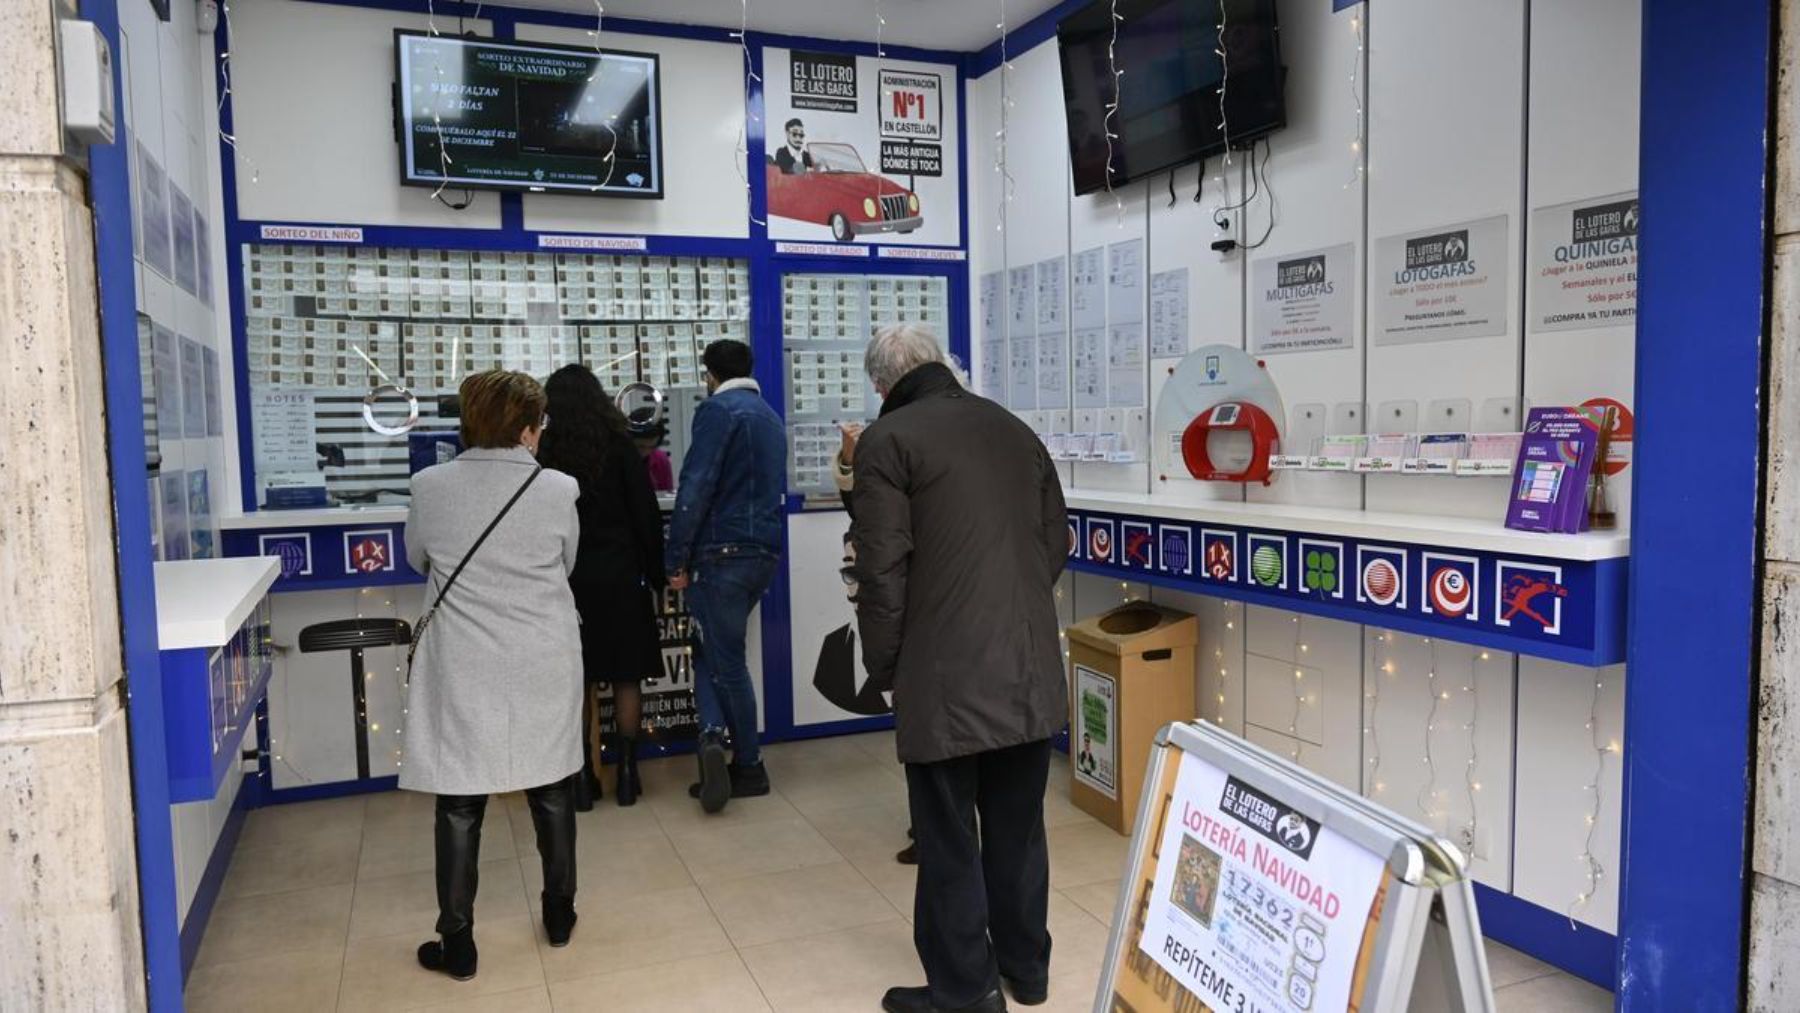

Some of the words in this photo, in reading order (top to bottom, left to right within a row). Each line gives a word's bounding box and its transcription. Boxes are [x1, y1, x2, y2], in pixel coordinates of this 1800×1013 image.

[477, 52, 511, 62] SORTEO
[512, 55, 587, 69] EXTRAORDINARIO
[499, 62, 515, 73] DE
[517, 64, 567, 77] NAVIDAD
[793, 61, 807, 79] EL
[810, 63, 854, 84] LOTERO
[793, 78, 807, 93] DE
[808, 81, 826, 95] LAS
[827, 82, 854, 97] GAFAS
[883, 76, 937, 90] ADMINISTRACIÓN
[459, 84, 500, 97] FALTAN
[459, 98, 484, 111] DÍAS
[884, 121, 894, 132] EN
[895, 122, 937, 135] CASTELLÓN
[883, 145, 893, 156] LA
[894, 146, 909, 157] MÁS
[910, 147, 939, 159] ANTIGUA
[919, 159, 939, 171] TOCA
[1575, 218, 1586, 231] EL
[1588, 211, 1621, 229] LOTERO
[264, 227, 308, 239] SORTEO
[310, 228, 330, 239] DEL
[332, 228, 360, 240] NIÑO
[1585, 227, 1599, 238] LAS
[544, 237, 577, 247] SORTEO
[578, 238, 593, 248] DE
[597, 239, 640, 249] NAVIDAD
[783, 245, 815, 254] SORTEO
[817, 246, 828, 254] DE
[888, 249, 917, 258] SORTEO
[918, 250, 929, 258] DE
[1585, 256, 1629, 271] QUINIELA
[1395, 260, 1476, 285] LOTOGAFAS
[1266, 281, 1334, 301] MULTIGAFAS
[1608, 292, 1624, 304] por
[1225, 783, 1239, 801] EL
[1238, 790, 1278, 821] LOTERO
[1222, 797, 1235, 812] DE
[1234, 803, 1250, 820] LAS
[1249, 810, 1274, 833] GAFAS
[1181, 800, 1248, 863] LOTERÍA
[1251, 842, 1341, 919] NAVIDAD
[1163, 933, 1235, 1007] REPÍTEME
[1235, 992, 1247, 1013] 3
